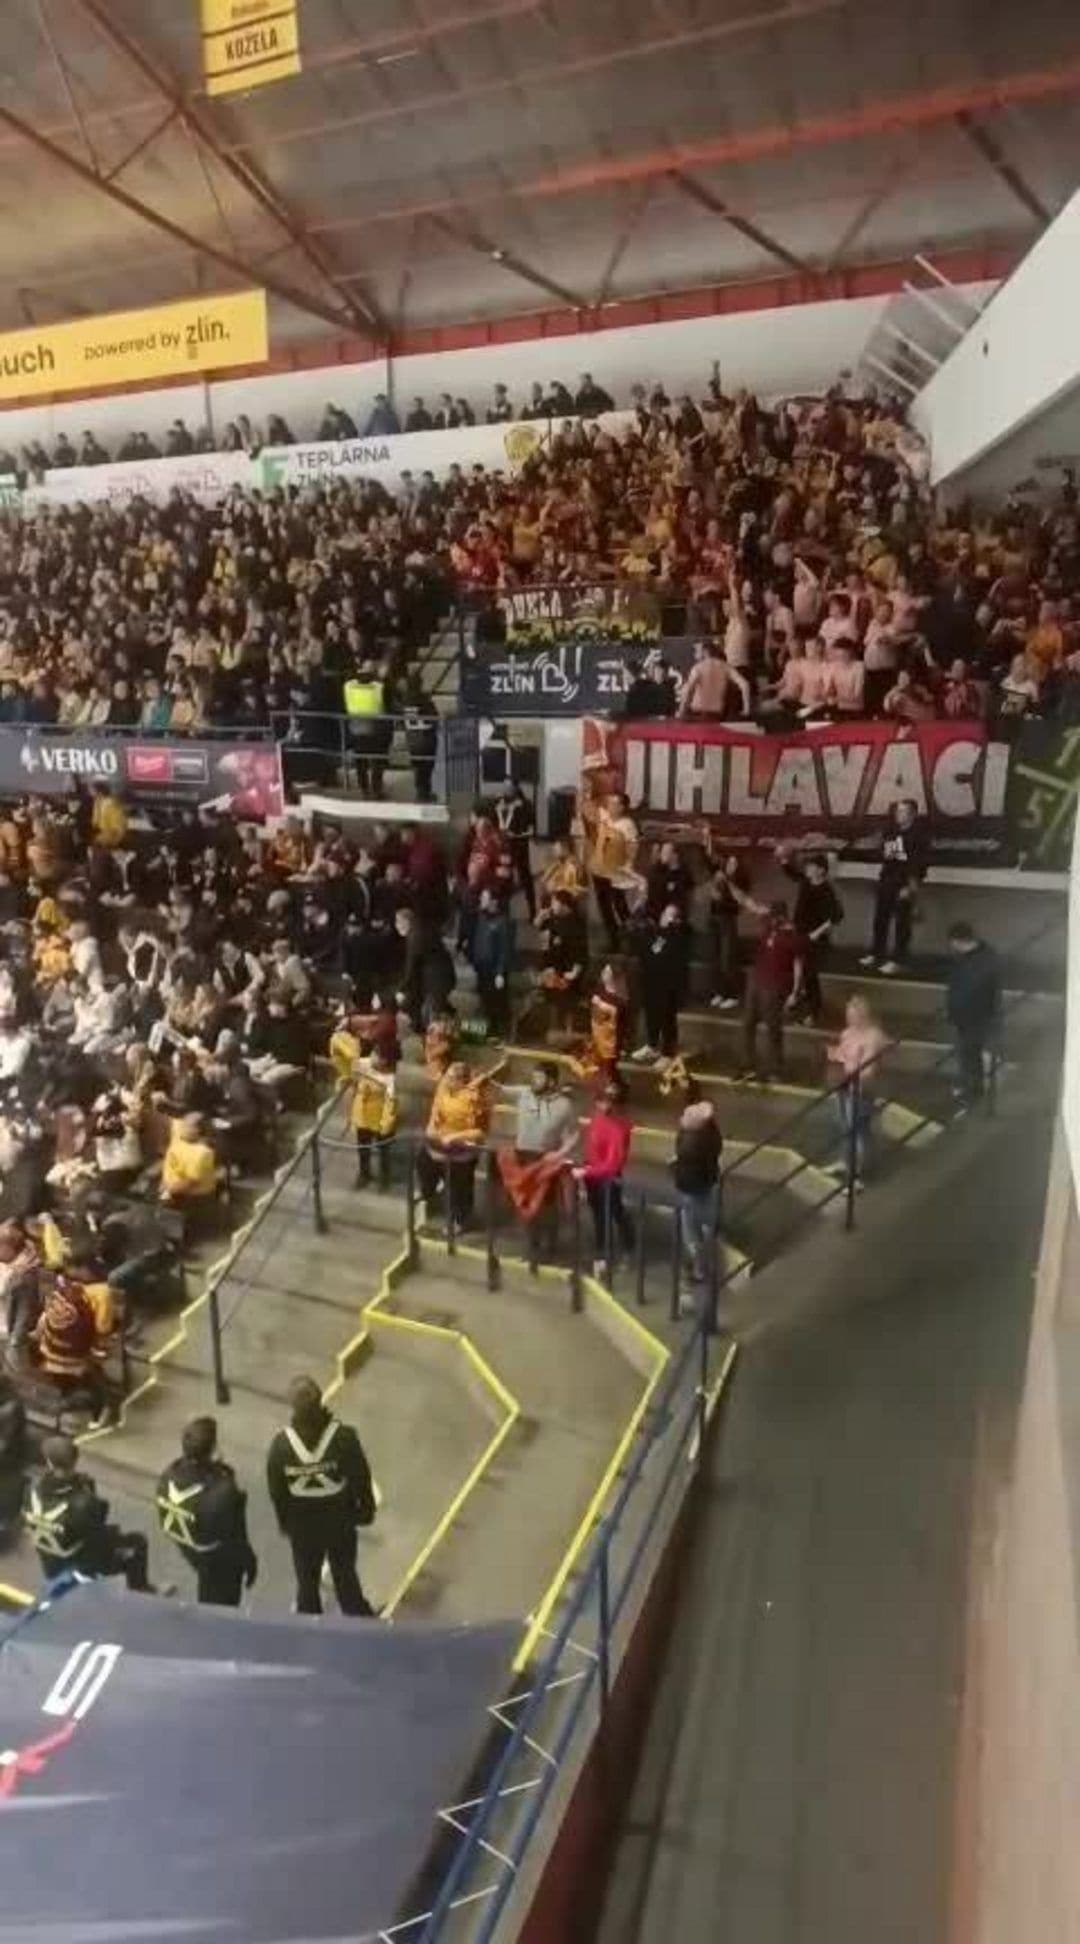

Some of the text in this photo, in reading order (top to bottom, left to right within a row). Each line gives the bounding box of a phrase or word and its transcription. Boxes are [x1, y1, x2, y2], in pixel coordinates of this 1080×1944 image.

[0, 345, 55, 377] uch
[84, 334, 157, 360] powered
[161, 331, 181, 348] by
[41, 748, 118, 773] VERKO
